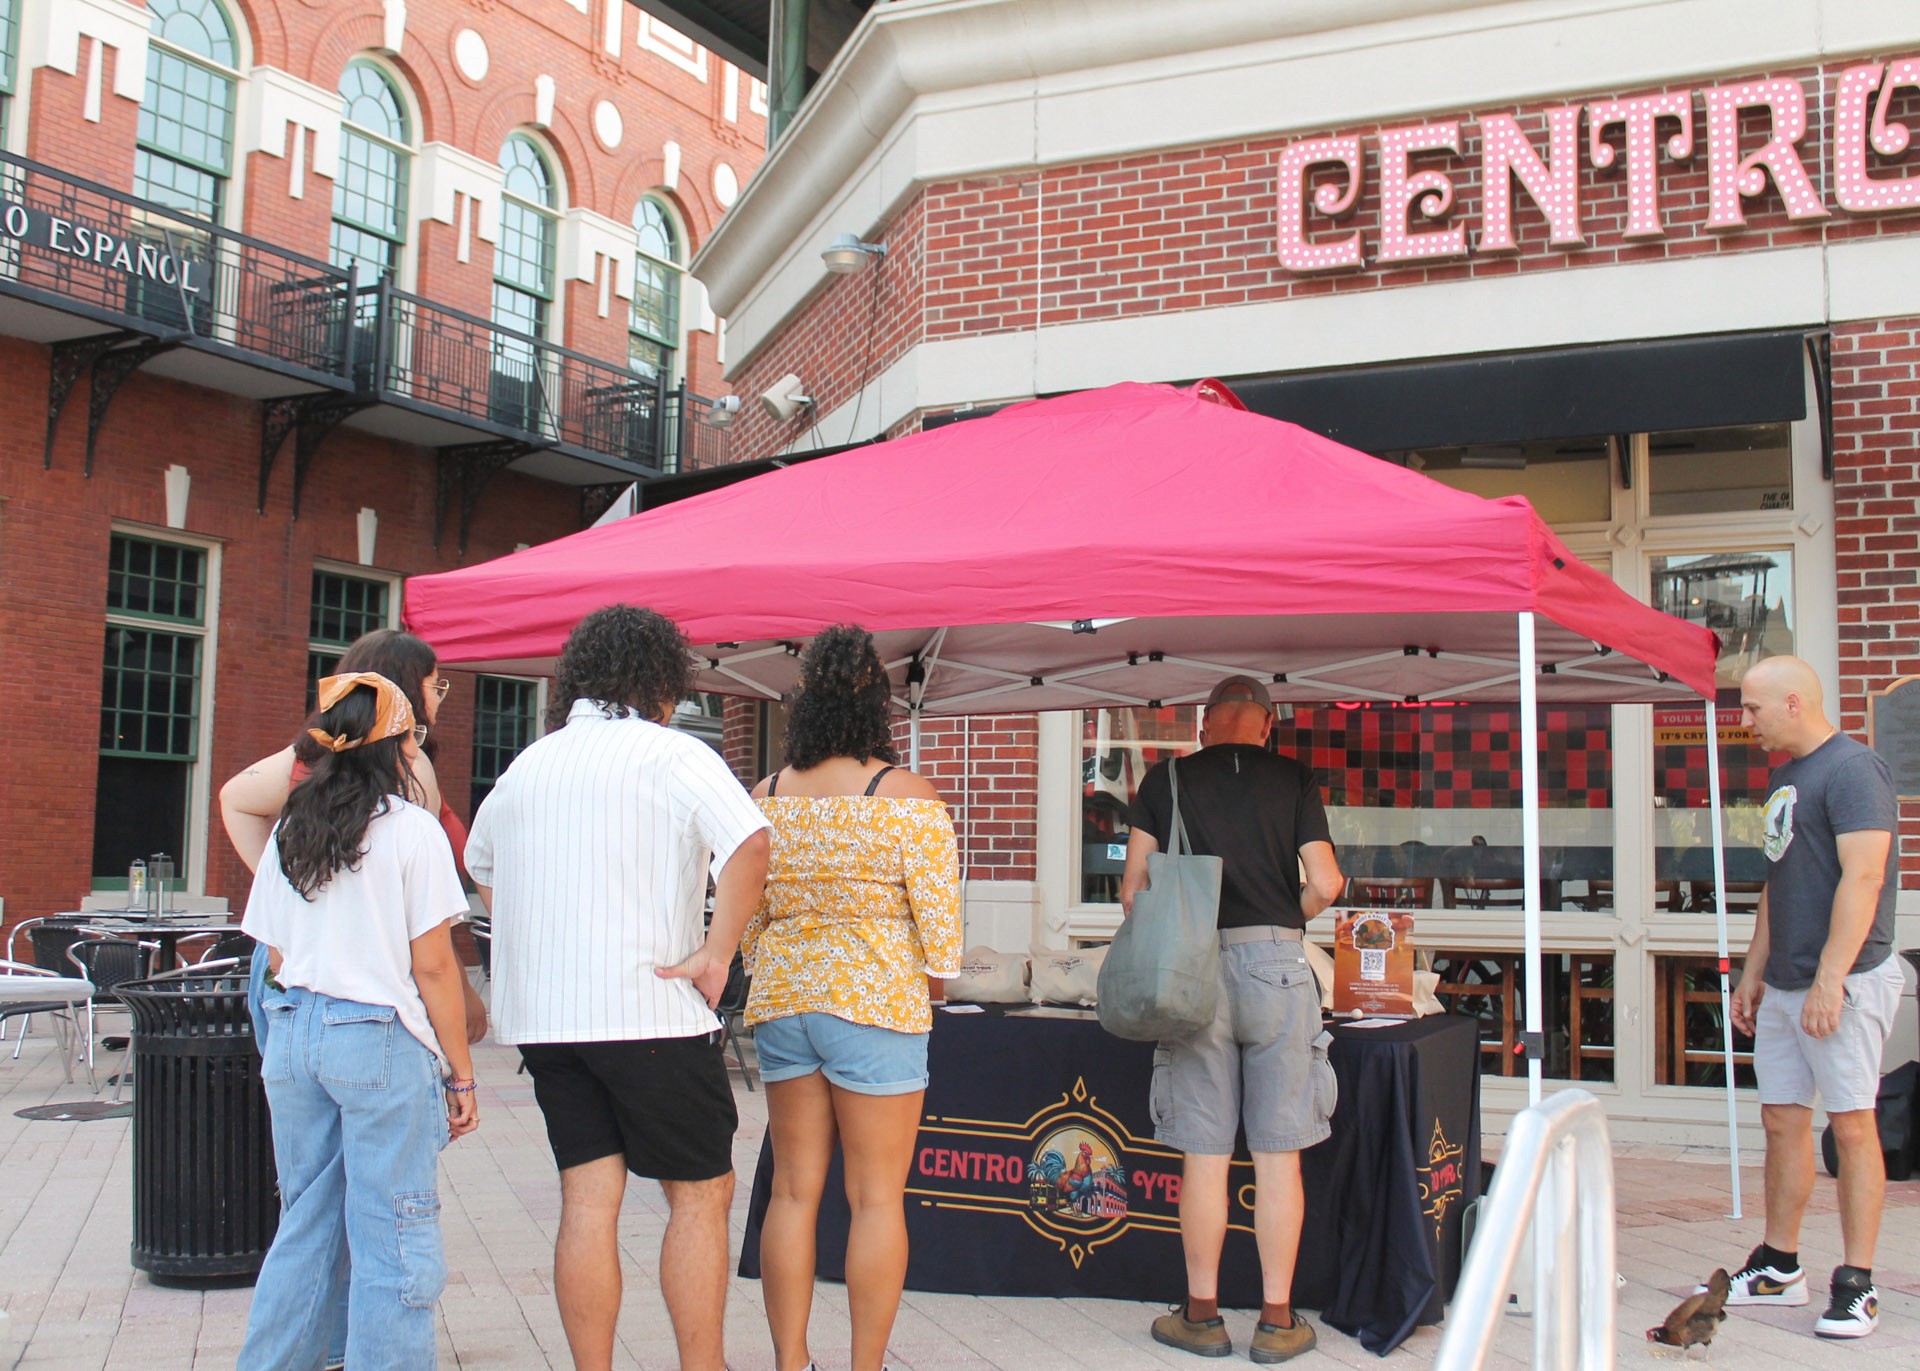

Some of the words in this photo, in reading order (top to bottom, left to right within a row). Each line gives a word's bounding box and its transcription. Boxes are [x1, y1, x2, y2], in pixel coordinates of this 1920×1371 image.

[49, 216, 200, 293] ESPAÑOL
[1662, 714, 1692, 723] YOUR
[1660, 731, 1681, 740] IT'S
[1728, 731, 1750, 740] FOR
[919, 1147, 1023, 1185] CENTRO
